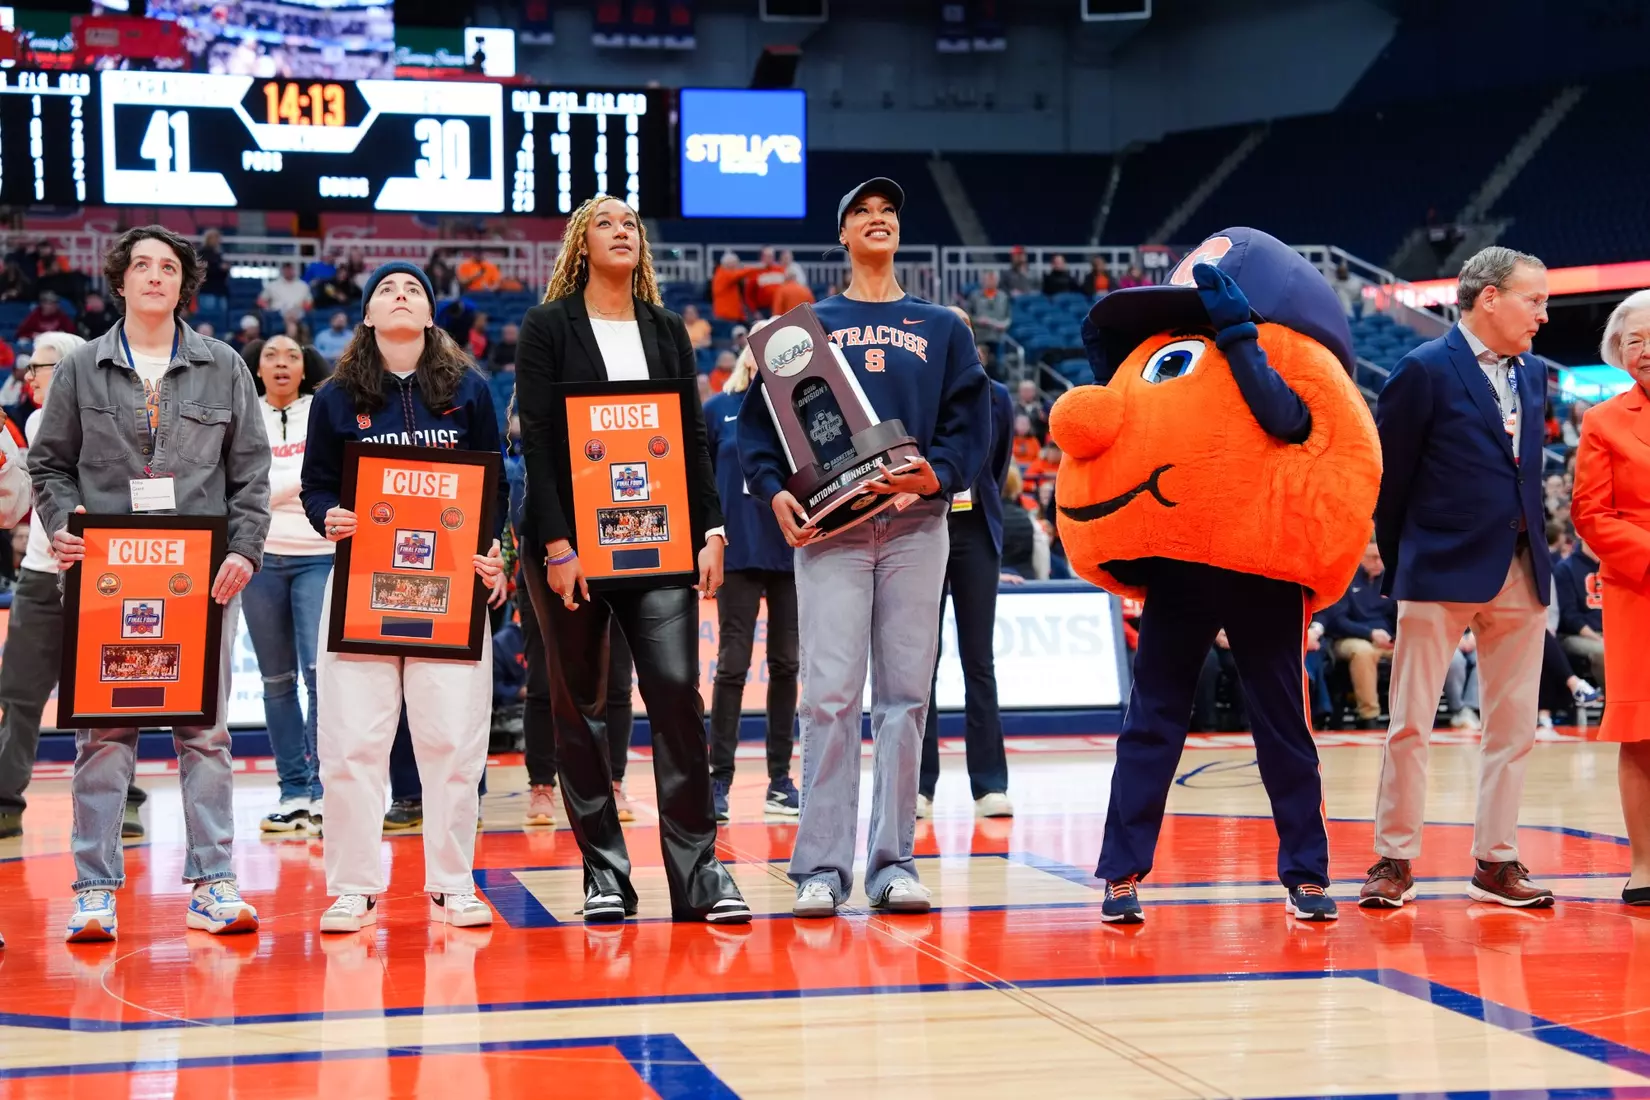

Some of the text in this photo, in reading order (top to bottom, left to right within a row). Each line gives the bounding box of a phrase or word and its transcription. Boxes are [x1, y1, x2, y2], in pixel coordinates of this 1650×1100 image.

[70, 96, 83, 117] 2
[264, 82, 345, 126] 14:13
[140, 110, 190, 173] 41
[414, 118, 471, 180] 30
[828, 325, 928, 361] YRACUSE
[771, 338, 813, 373] NCAA
[865, 349, 885, 372] S
[798, 386, 824, 408] DIVISION
[802, 384, 816, 396] 2016
[356, 412, 372, 430] S
[592, 404, 653, 429] 'CUSE
[362, 429, 458, 449] RACUSE
[812, 425, 828, 438] FINAL
[386, 470, 451, 498] 'CUSE
[809, 480, 842, 508] NATIONAL
[841, 456, 884, 486] RUNNER-UP
[112, 540, 178, 564] 'CUSE
